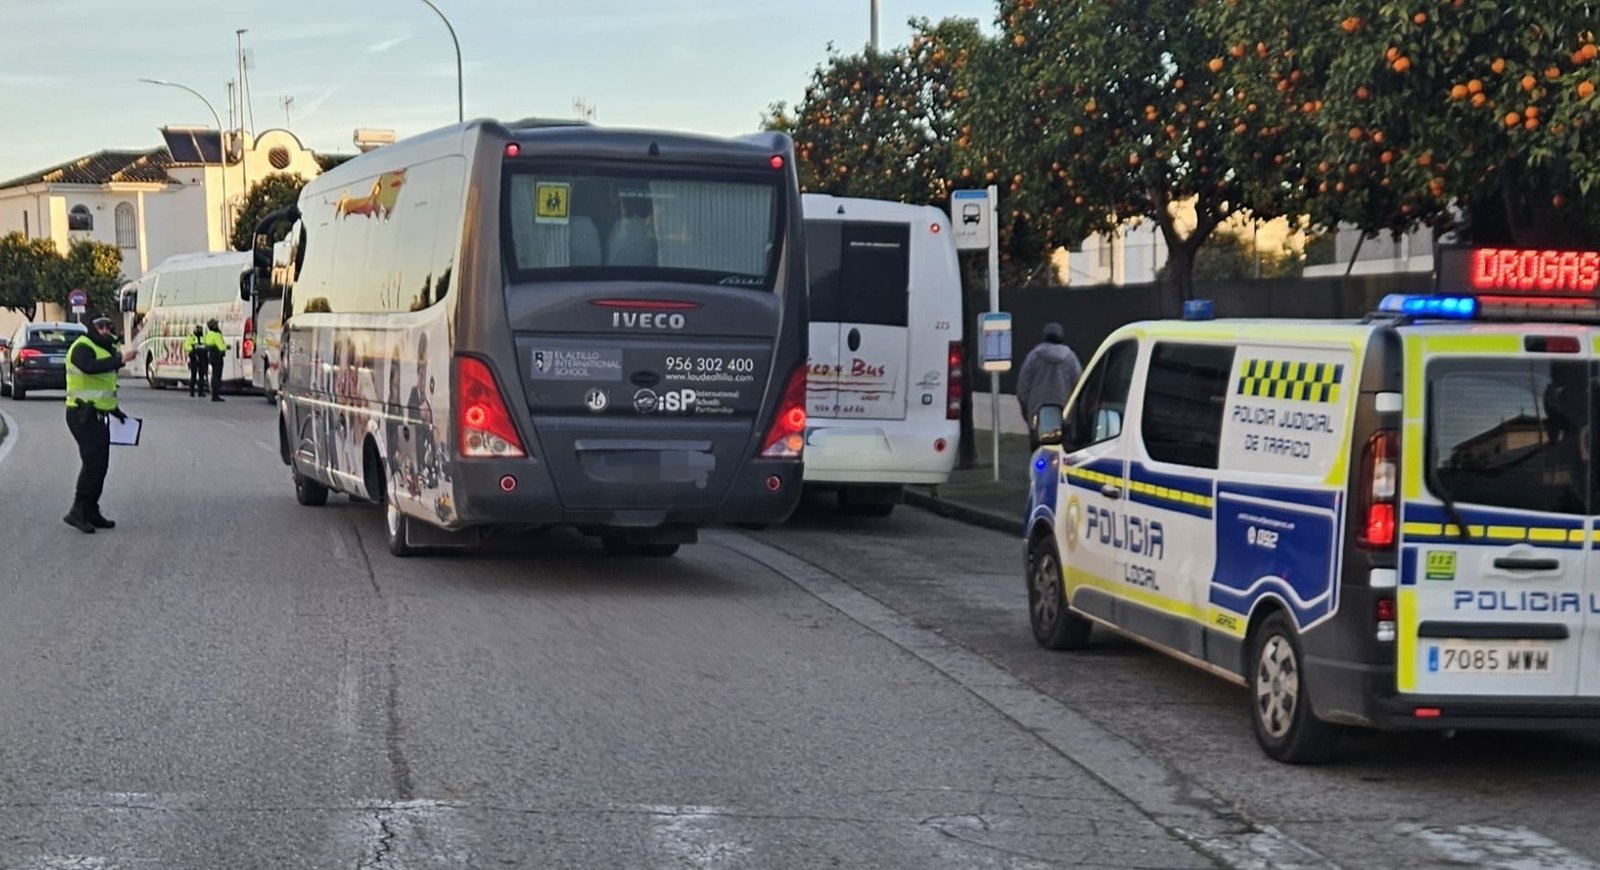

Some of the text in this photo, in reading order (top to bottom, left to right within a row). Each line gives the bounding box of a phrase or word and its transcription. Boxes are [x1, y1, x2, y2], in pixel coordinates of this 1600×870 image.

[1475, 248, 1600, 289] DROGAS
[612, 312, 686, 330] IVECO
[554, 359, 622, 369] INTERNATIONAL
[565, 351, 600, 360] ALTILLO
[666, 356, 754, 372] 956 302 400
[554, 367, 590, 377] SCHOOL
[852, 358, 886, 377] Bus
[1279, 411, 1334, 433] JUDICIAL
[1245, 434, 1259, 451] DE
[1430, 555, 1454, 565] 112
[1123, 562, 1160, 591] LOCAL
[1443, 649, 1549, 671] 7085 MWM
